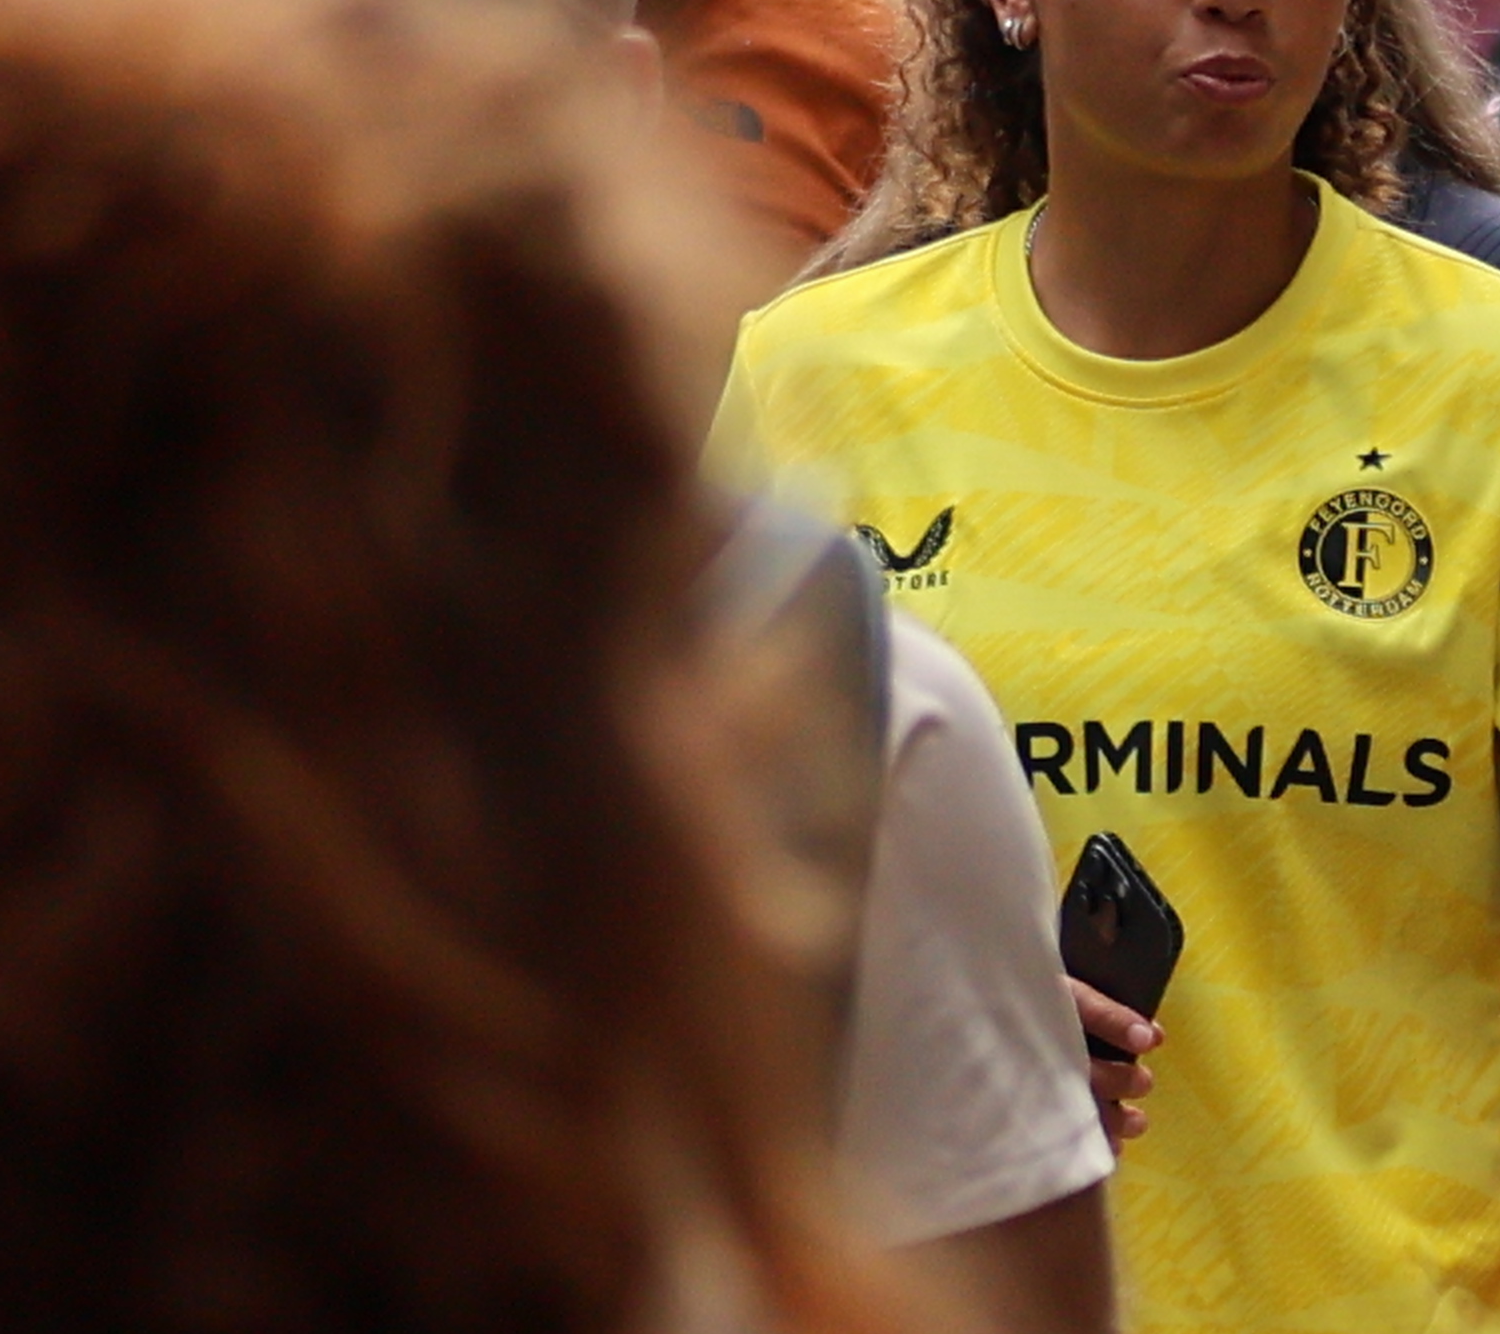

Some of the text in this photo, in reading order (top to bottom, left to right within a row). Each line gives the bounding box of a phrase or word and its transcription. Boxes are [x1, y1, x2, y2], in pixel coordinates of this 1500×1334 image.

[1310, 491, 1427, 541] FEYENOORD
[1306, 571, 1424, 617] ROTTERDAM
[1014, 720, 1453, 808] RMINALS
